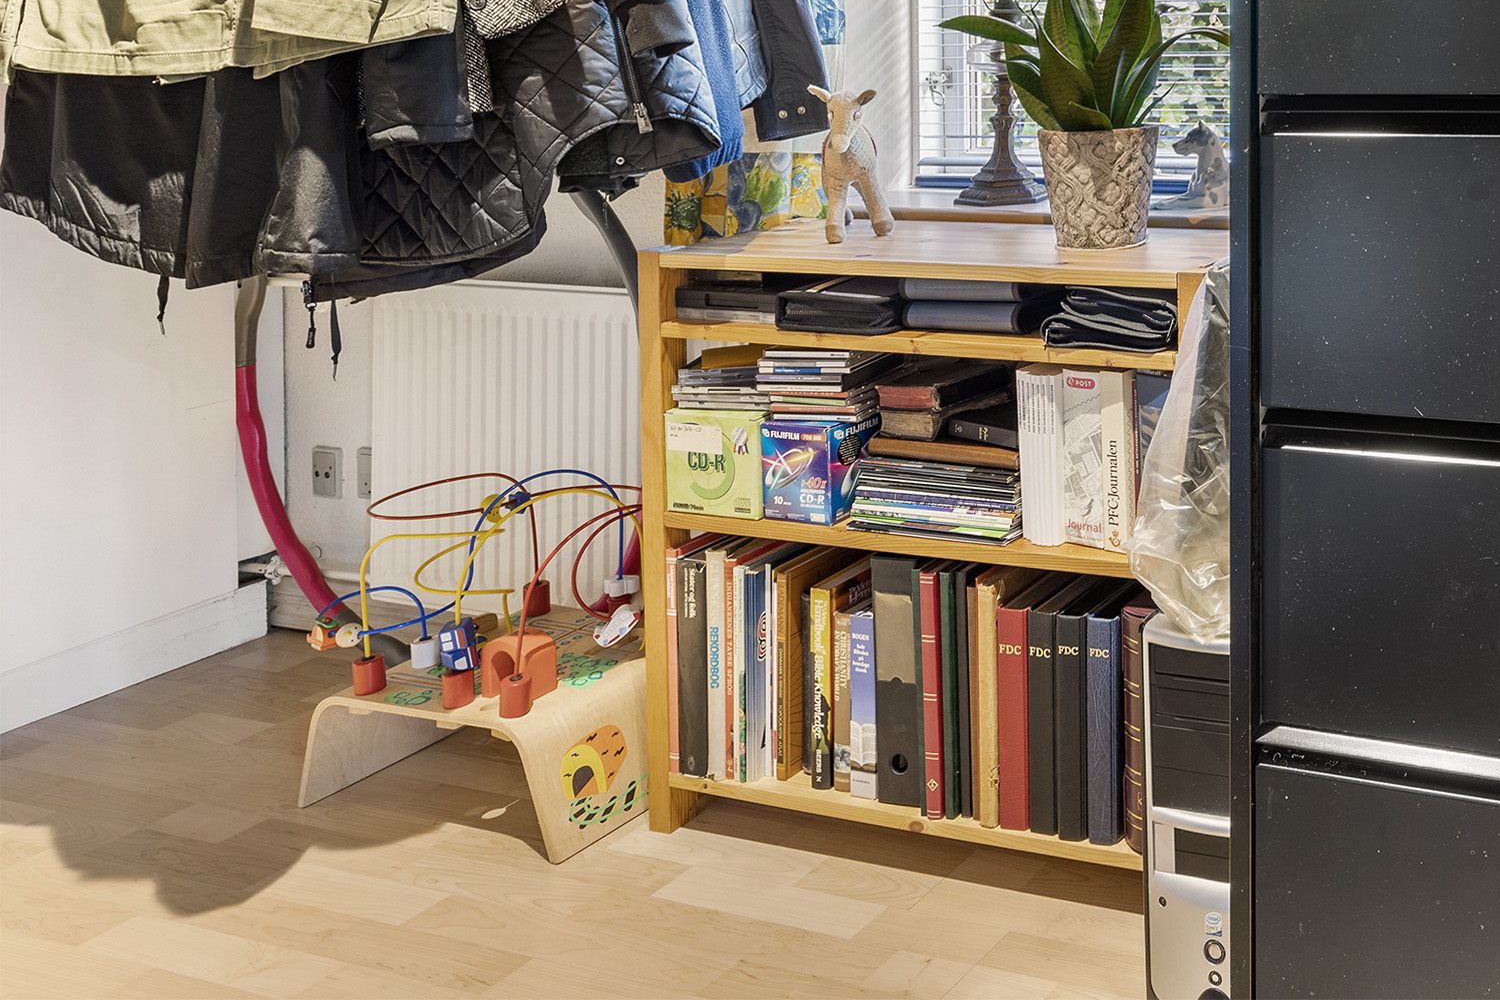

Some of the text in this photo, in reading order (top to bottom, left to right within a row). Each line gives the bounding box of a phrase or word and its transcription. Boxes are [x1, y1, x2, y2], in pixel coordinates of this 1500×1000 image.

[1075, 380, 1093, 388] POST
[845, 416, 880, 437] FUJIFILM
[770, 430, 801, 441] FUJIFILM
[687, 451, 726, 473] CD-R
[773, 495, 784, 505] 10
[800, 493, 826, 505] CD-R
[1067, 518, 1102, 534] Journal
[999, 644, 1022, 656] FDC
[1029, 646, 1051, 659] FDC
[1058, 645, 1079, 656] FDC
[1089, 647, 1110, 659] FDC
[710, 627, 719, 689] REKORDBOG
[814, 654, 824, 682] Bible
[813, 683, 826, 740] Knowledge
